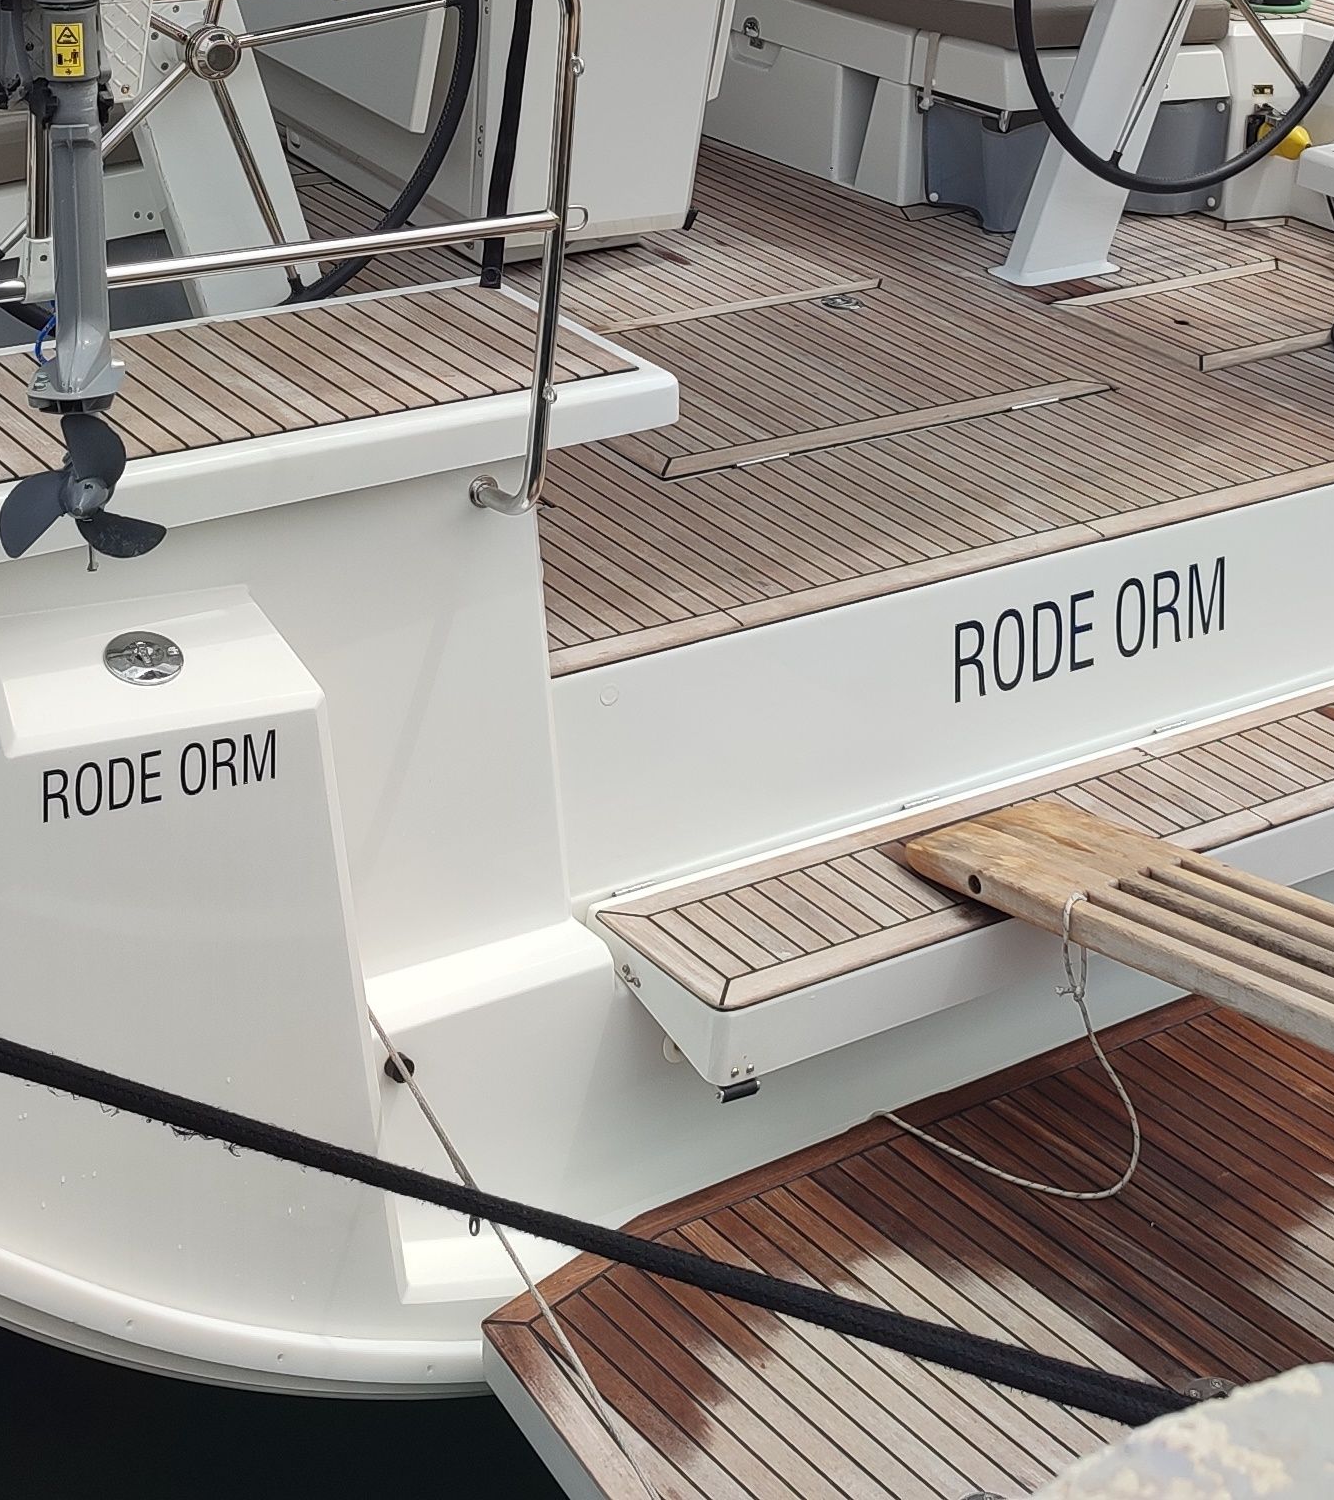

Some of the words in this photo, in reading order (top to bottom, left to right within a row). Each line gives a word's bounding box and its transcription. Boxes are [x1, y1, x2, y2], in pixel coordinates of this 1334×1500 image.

[953, 589, 1095, 704] RODE
[1115, 556, 1226, 658] ORM
[42, 749, 163, 824] RODE
[179, 729, 278, 797] ORM
